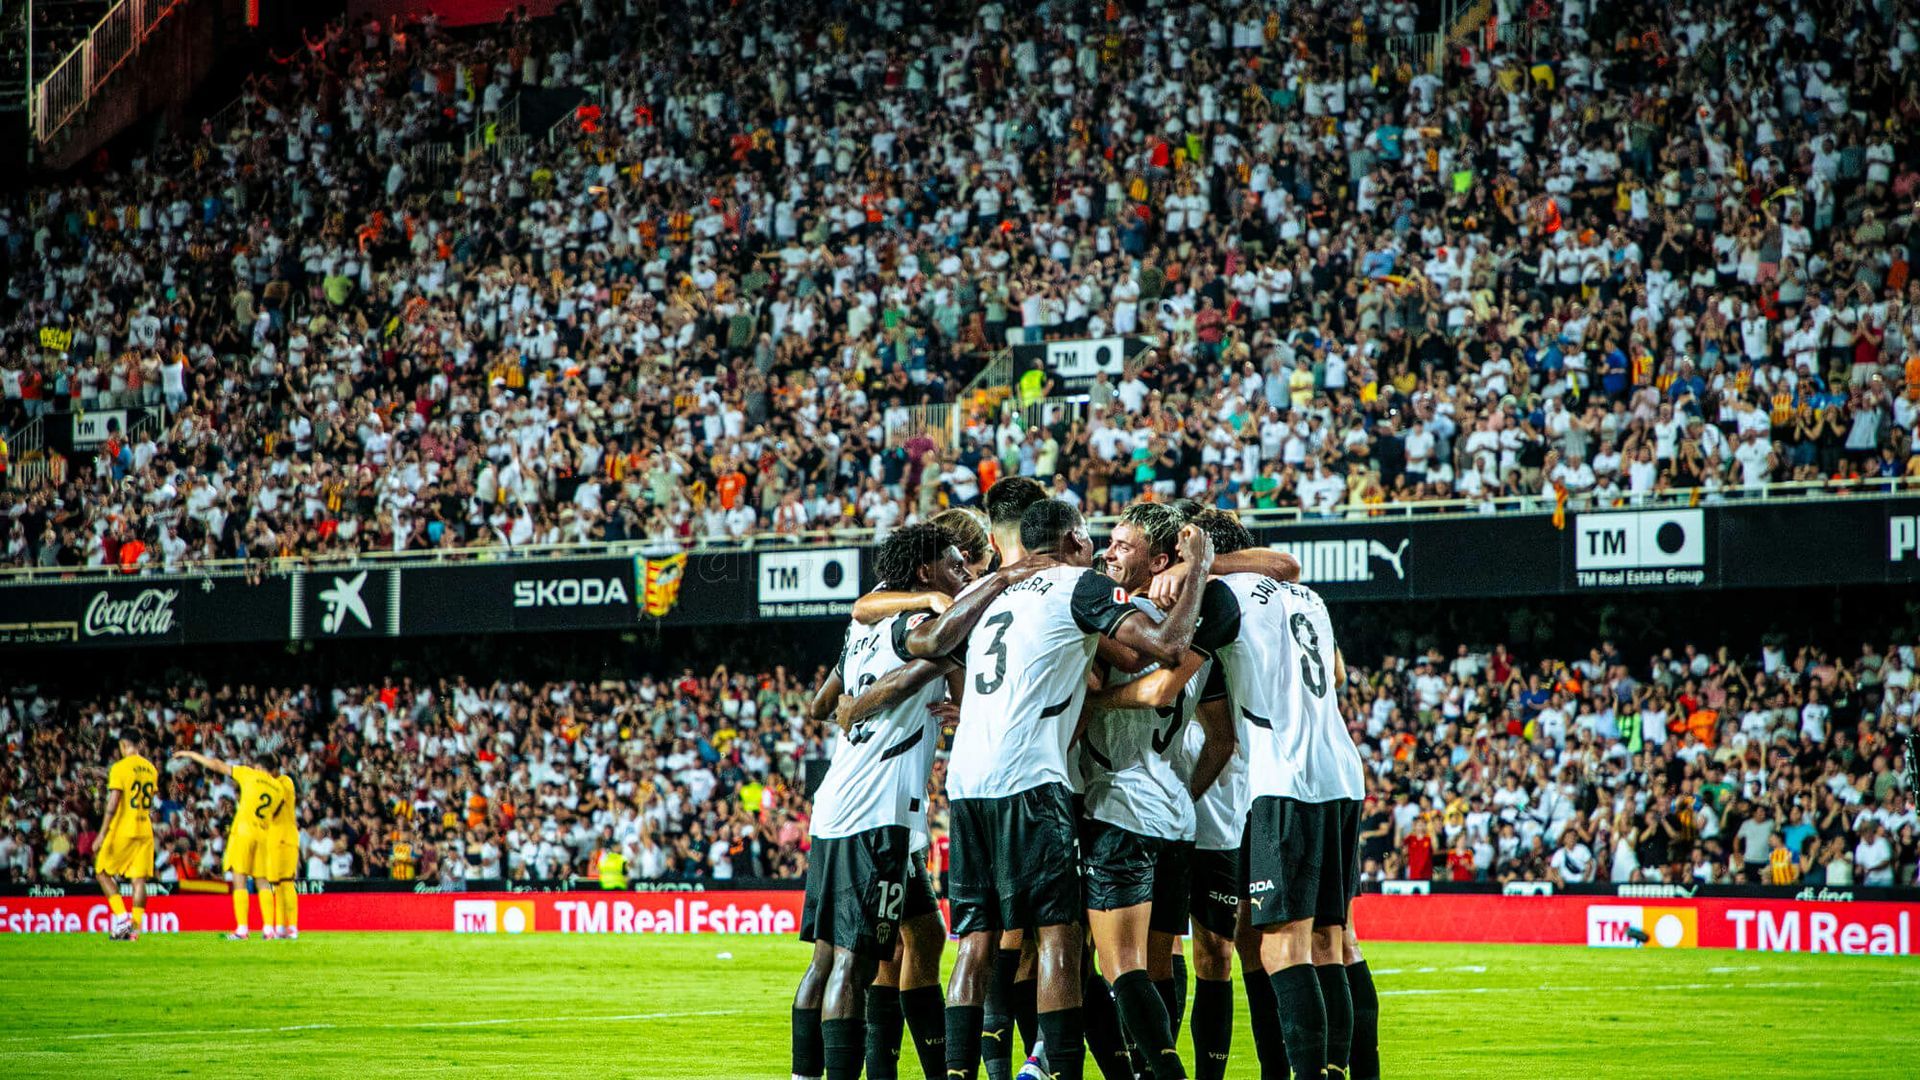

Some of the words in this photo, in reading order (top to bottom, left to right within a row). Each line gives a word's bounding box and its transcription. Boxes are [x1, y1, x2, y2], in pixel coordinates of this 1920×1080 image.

[1586, 529, 1626, 555] TM
[1270, 539, 1369, 583] UMA
[768, 567, 798, 591] TM
[1577, 571, 1597, 587] TM
[1599, 570, 1625, 586] Real
[1627, 569, 1664, 585] Estate
[1665, 568, 1704, 586] Group
[974, 611, 1014, 695] 3
[131, 780, 153, 809] 28
[878, 880, 903, 920] 12
[1209, 890, 1238, 905] SKO
[1249, 880, 1275, 894] ODA
[87, 904, 179, 933] Gup
[462, 913, 488, 932] TM
[554, 901, 607, 933] TM
[613, 899, 685, 933] Real
[690, 901, 796, 933] Estate
[1726, 909, 1800, 952] TM
[1810, 910, 1911, 955] Real
